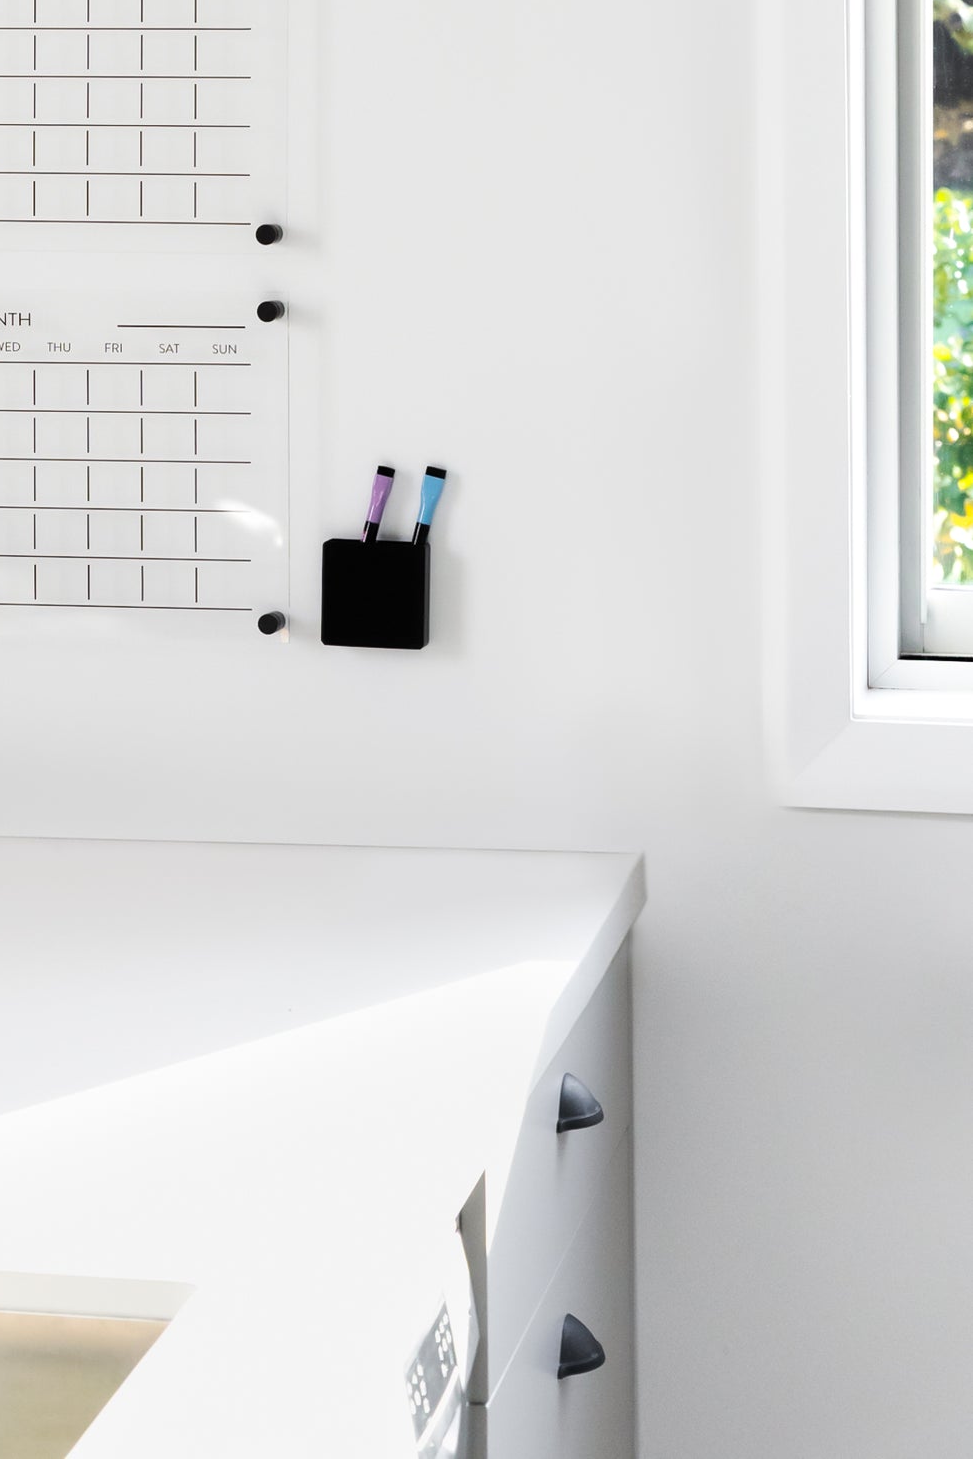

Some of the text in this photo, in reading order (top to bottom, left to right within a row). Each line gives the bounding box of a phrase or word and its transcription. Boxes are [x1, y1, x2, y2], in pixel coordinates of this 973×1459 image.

[46, 341, 72, 353] THU
[104, 342, 123, 354] FRI
[158, 343, 180, 354] SAT
[211, 343, 238, 355] SUN
